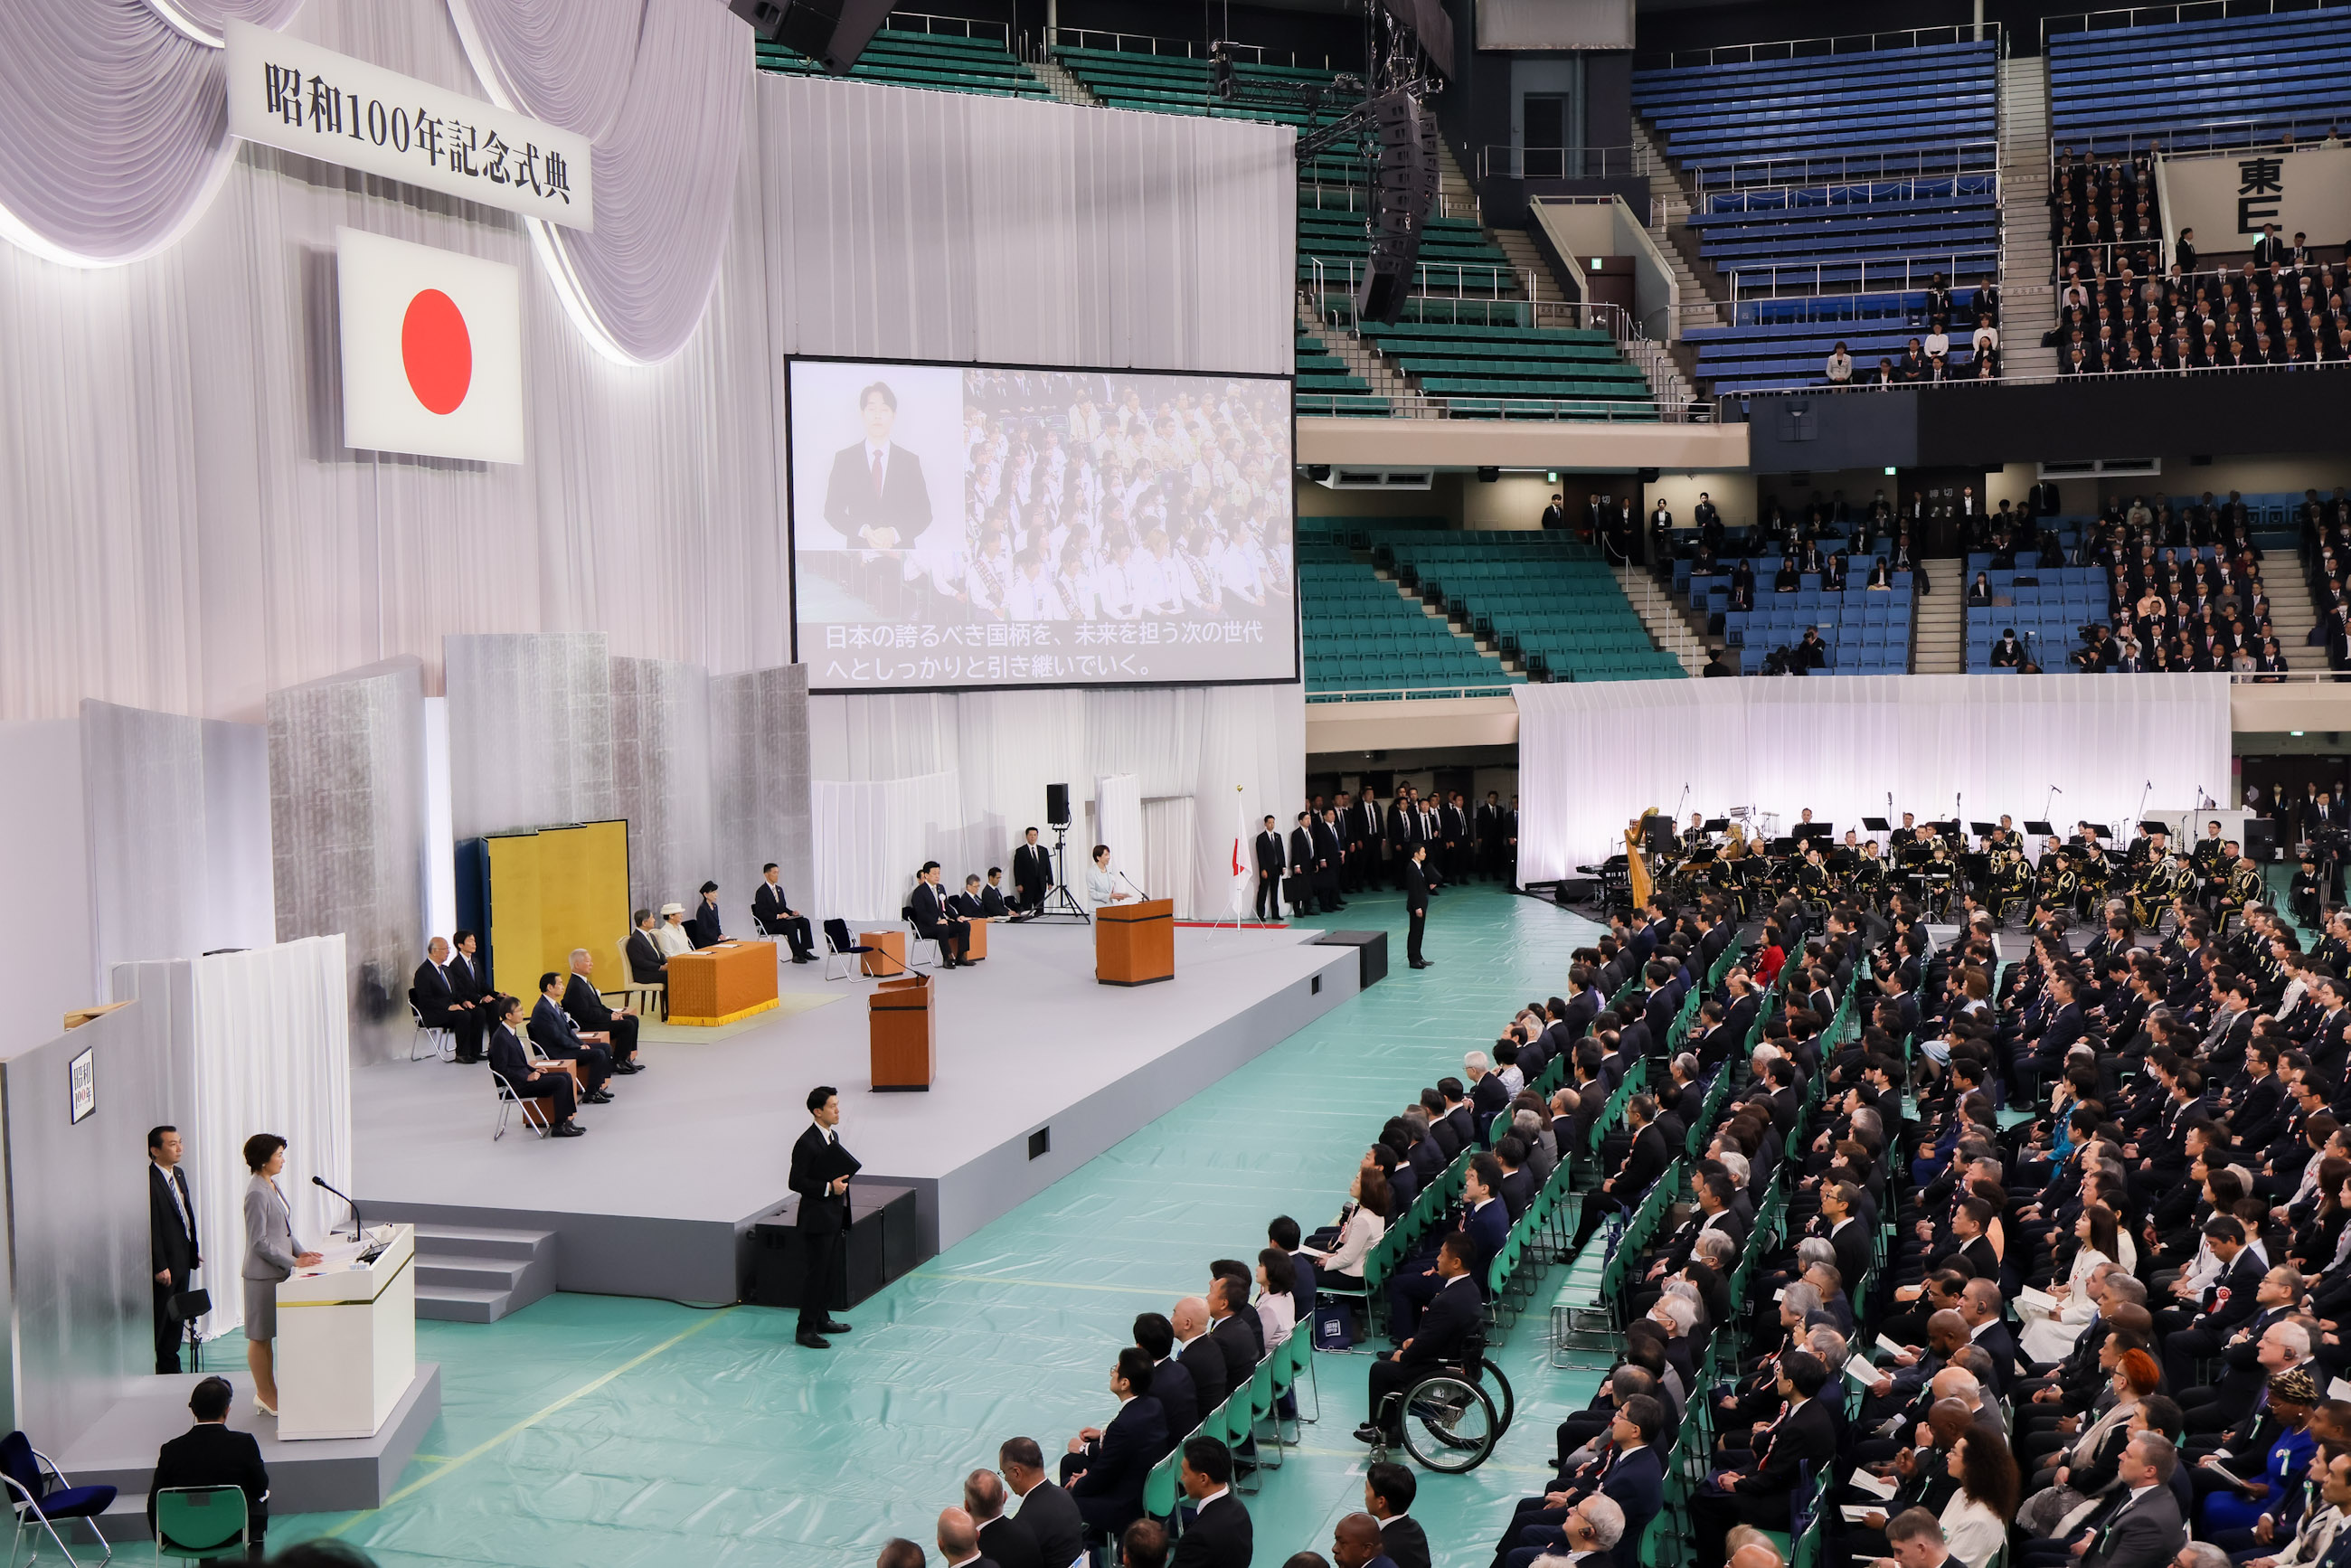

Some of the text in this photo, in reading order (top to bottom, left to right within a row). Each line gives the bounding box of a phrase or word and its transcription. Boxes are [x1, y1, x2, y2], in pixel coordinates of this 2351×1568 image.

[264, 61, 571, 204] 昭和100年記念式典
[826, 620, 1263, 649] 日本の誇るべき国柄を、未来を担う次の世代
[826, 653, 1149, 680] へとしっかりと引き継いでいく。
[74, 1062, 91, 1091] 昭和
